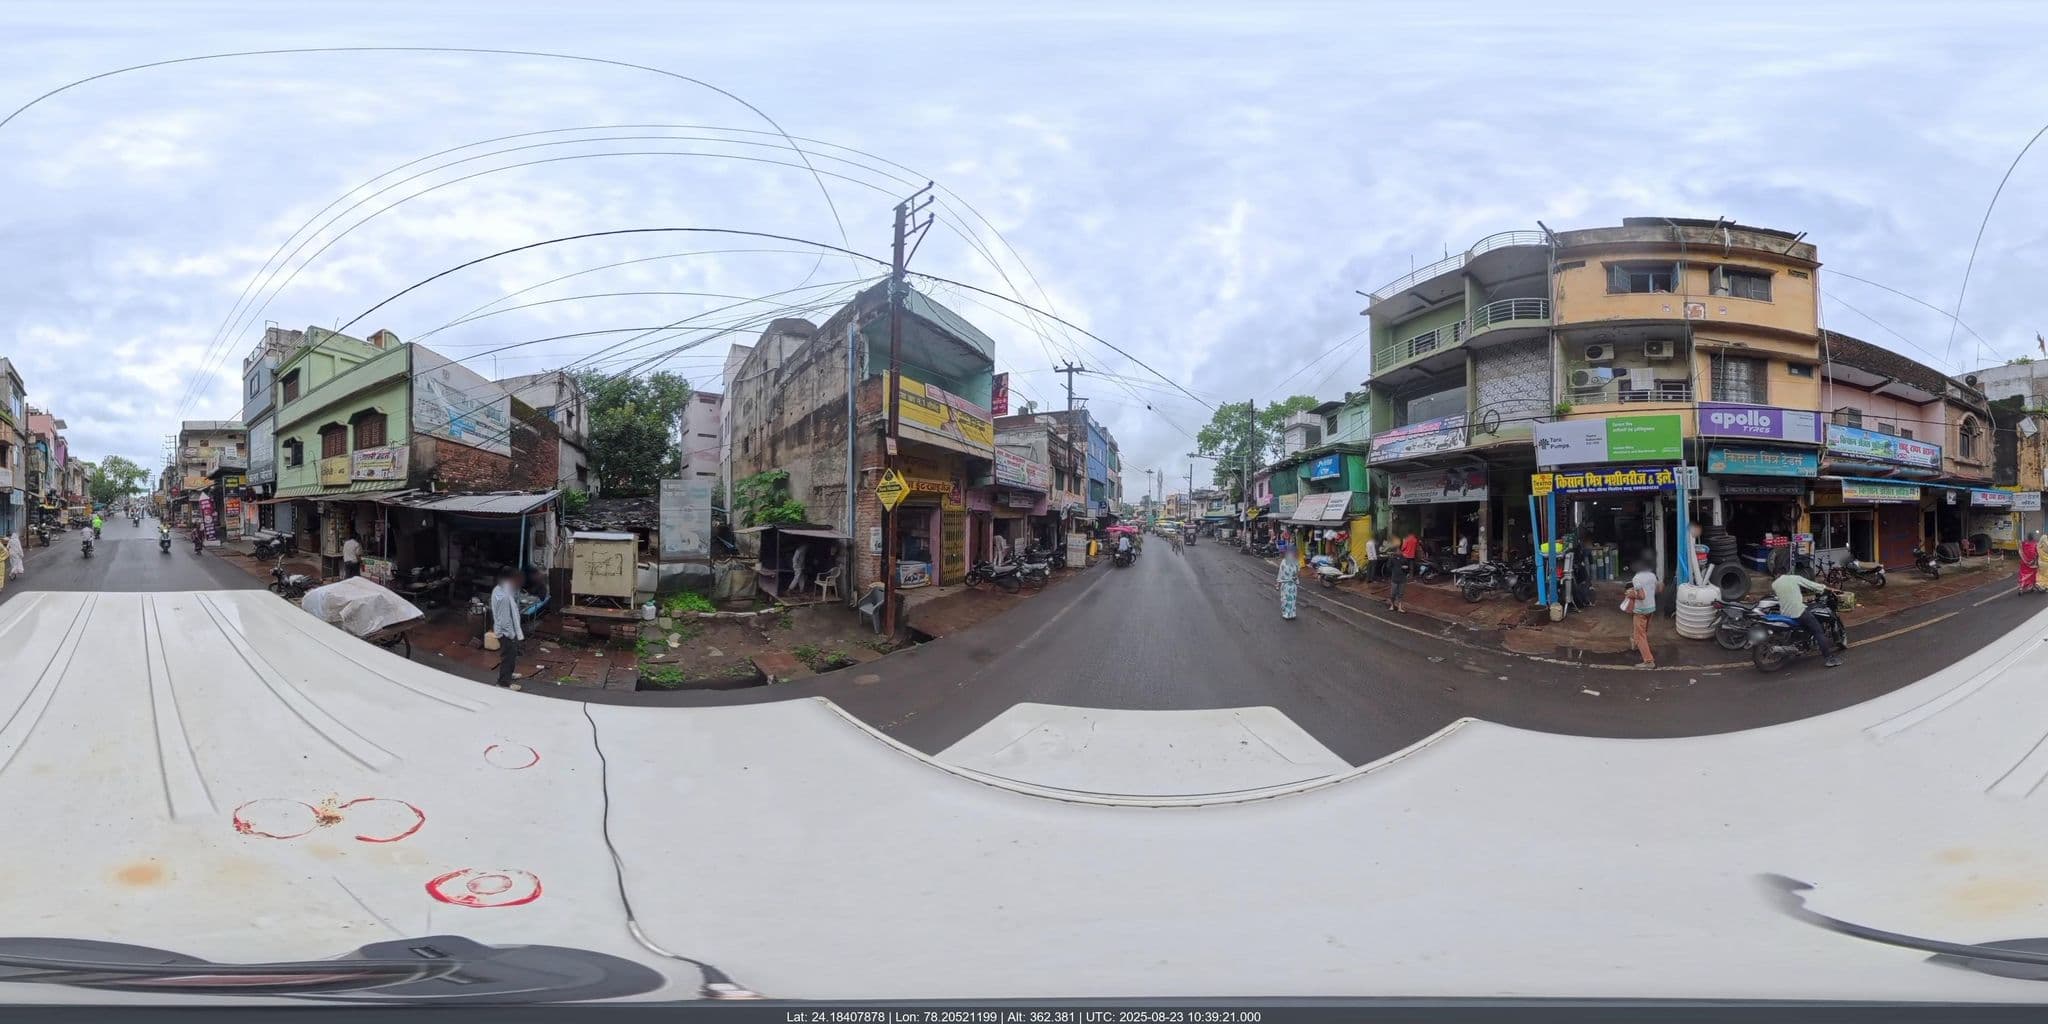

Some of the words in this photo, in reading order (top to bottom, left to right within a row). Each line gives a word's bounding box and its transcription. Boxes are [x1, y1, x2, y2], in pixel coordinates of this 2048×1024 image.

[1711, 410, 1771, 429] apollo
[1743, 425, 1771, 434] TYRES
[1723, 448, 1758, 463] किसान
[1760, 450, 1779, 465] मित्र
[1556, 473, 1585, 489] किसान
[1585, 472, 1603, 487] मित्र
[1648, 475, 1655, 485] &
